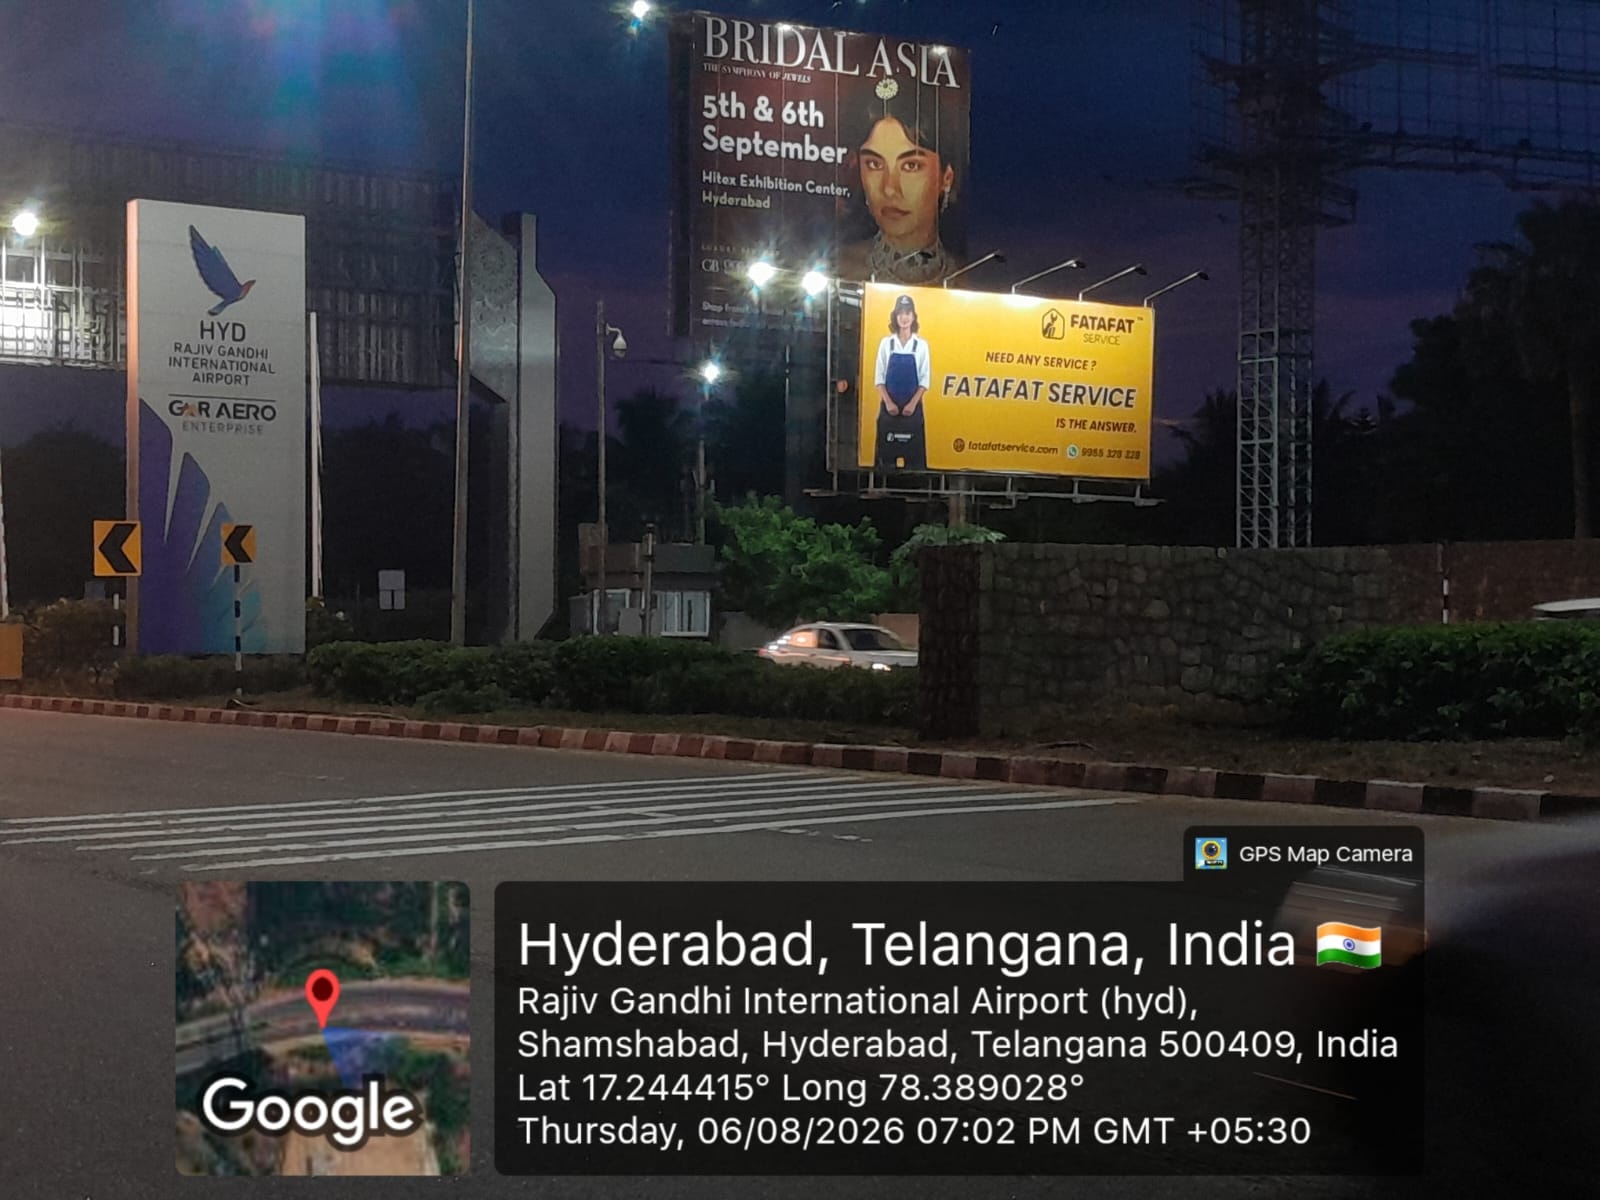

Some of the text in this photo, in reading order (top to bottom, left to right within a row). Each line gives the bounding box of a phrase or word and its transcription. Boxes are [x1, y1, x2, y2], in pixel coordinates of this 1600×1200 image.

[704, 16, 960, 88] BRIDAL ASIA
[702, 91, 824, 128] 5th & 6th
[702, 125, 848, 163] September
[702, 170, 851, 198] Hitex Exhibition Center,
[702, 191, 771, 209] Hyderabad
[200, 320, 246, 342] HYD
[1070, 314, 1135, 334] FATAFAT
[1083, 333, 1121, 346] SERVICE
[174, 342, 268, 360] RAJIV GANDHI
[985, 351, 1014, 364] NEED
[1016, 354, 1041, 366] ANY
[1043, 357, 1088, 371] SERVICE
[168, 356, 276, 375] INTERNATIONAL
[192, 372, 250, 386] AIRPORT
[943, 375, 1137, 409] FATAFAT SERVICE
[215, 402, 277, 422] AERO
[182, 421, 264, 435] ENTERPRISE
[1056, 418, 1137, 433] IS THE ANSWER.
[968, 441, 1059, 455] fatafatservice.com
